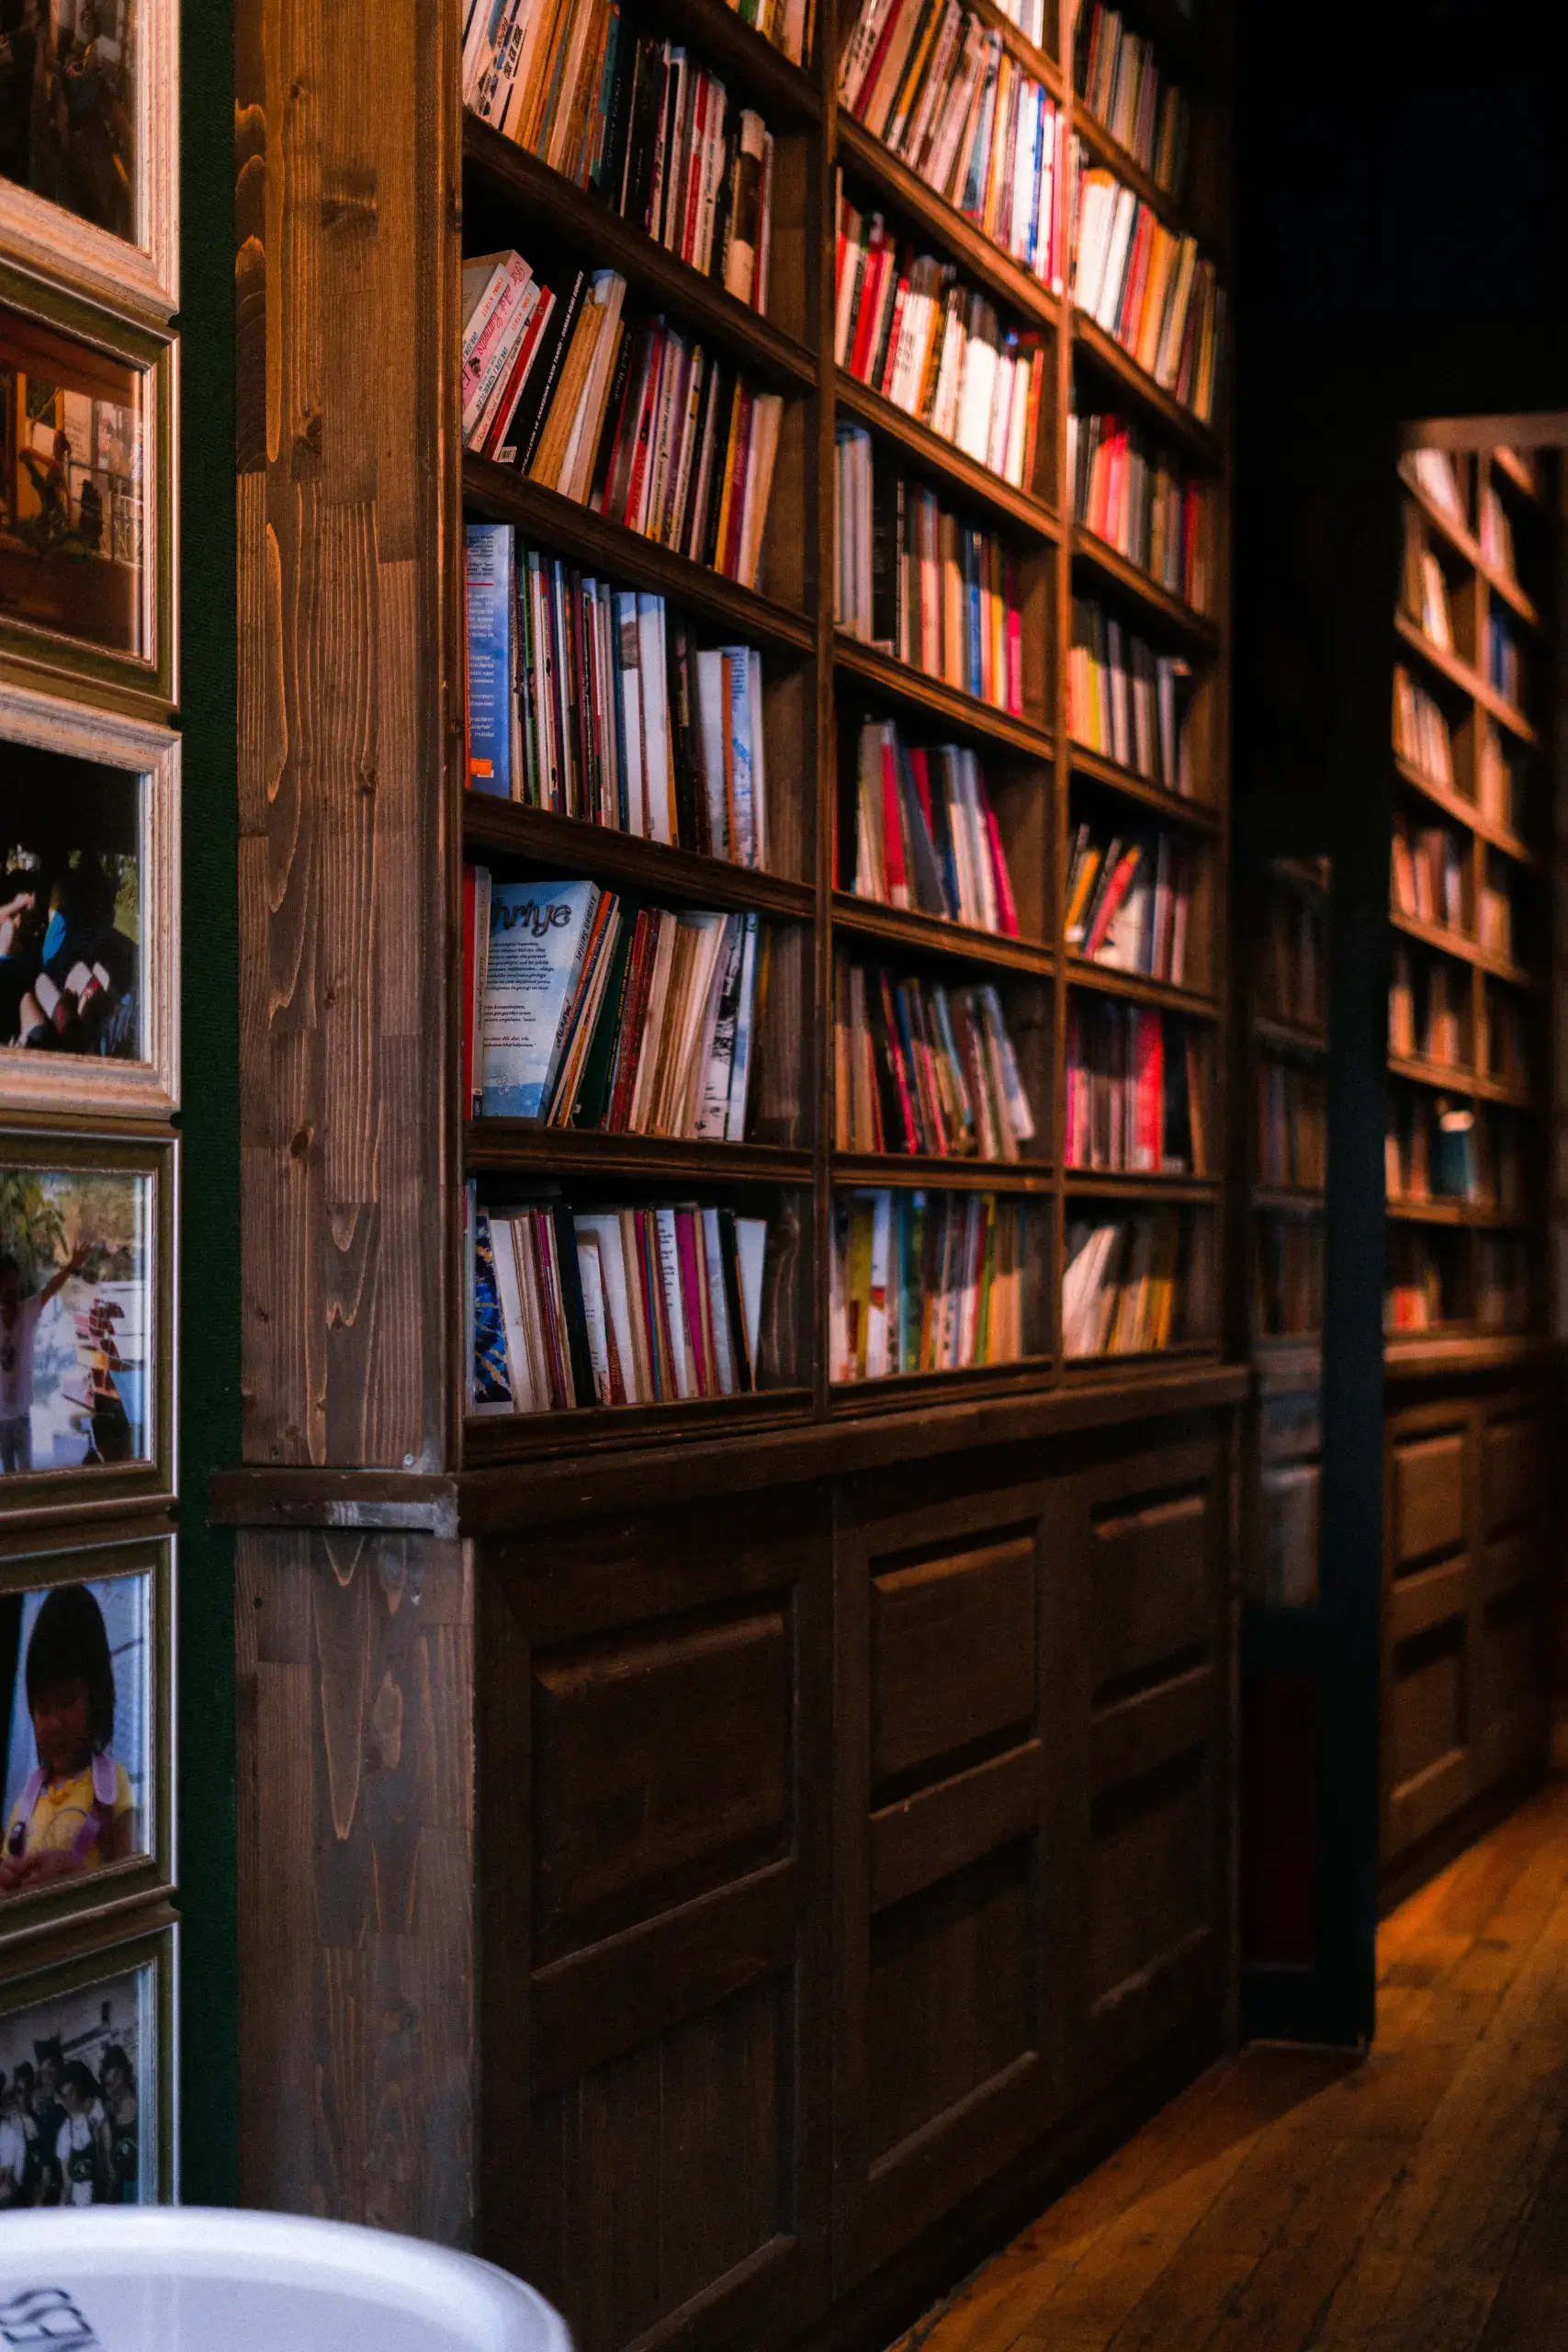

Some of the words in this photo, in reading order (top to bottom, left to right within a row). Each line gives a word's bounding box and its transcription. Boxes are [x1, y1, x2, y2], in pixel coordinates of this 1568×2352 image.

[547, 363, 556, 383] YAKIN
[561, 313, 571, 337] OSMAN
[491, 897, 572, 938] hriye
[584, 894, 597, 928] Asuman
